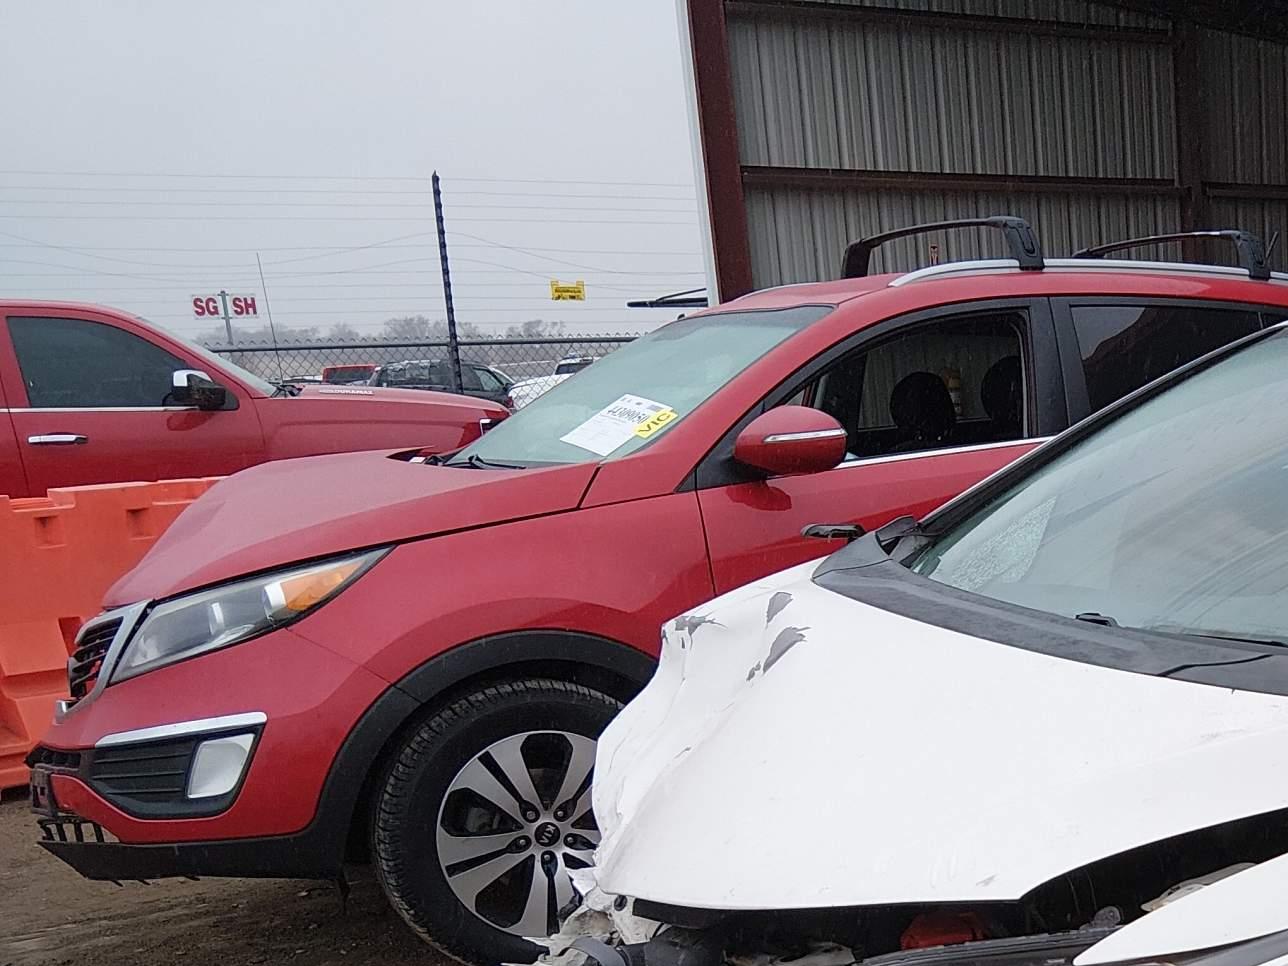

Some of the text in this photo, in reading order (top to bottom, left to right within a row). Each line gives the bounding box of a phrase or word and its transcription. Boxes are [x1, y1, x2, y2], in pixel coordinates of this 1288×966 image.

[193, 297, 258, 317] SG SH
[638, 413, 671, 433] VIC
[538, 824, 556, 844] KIA
